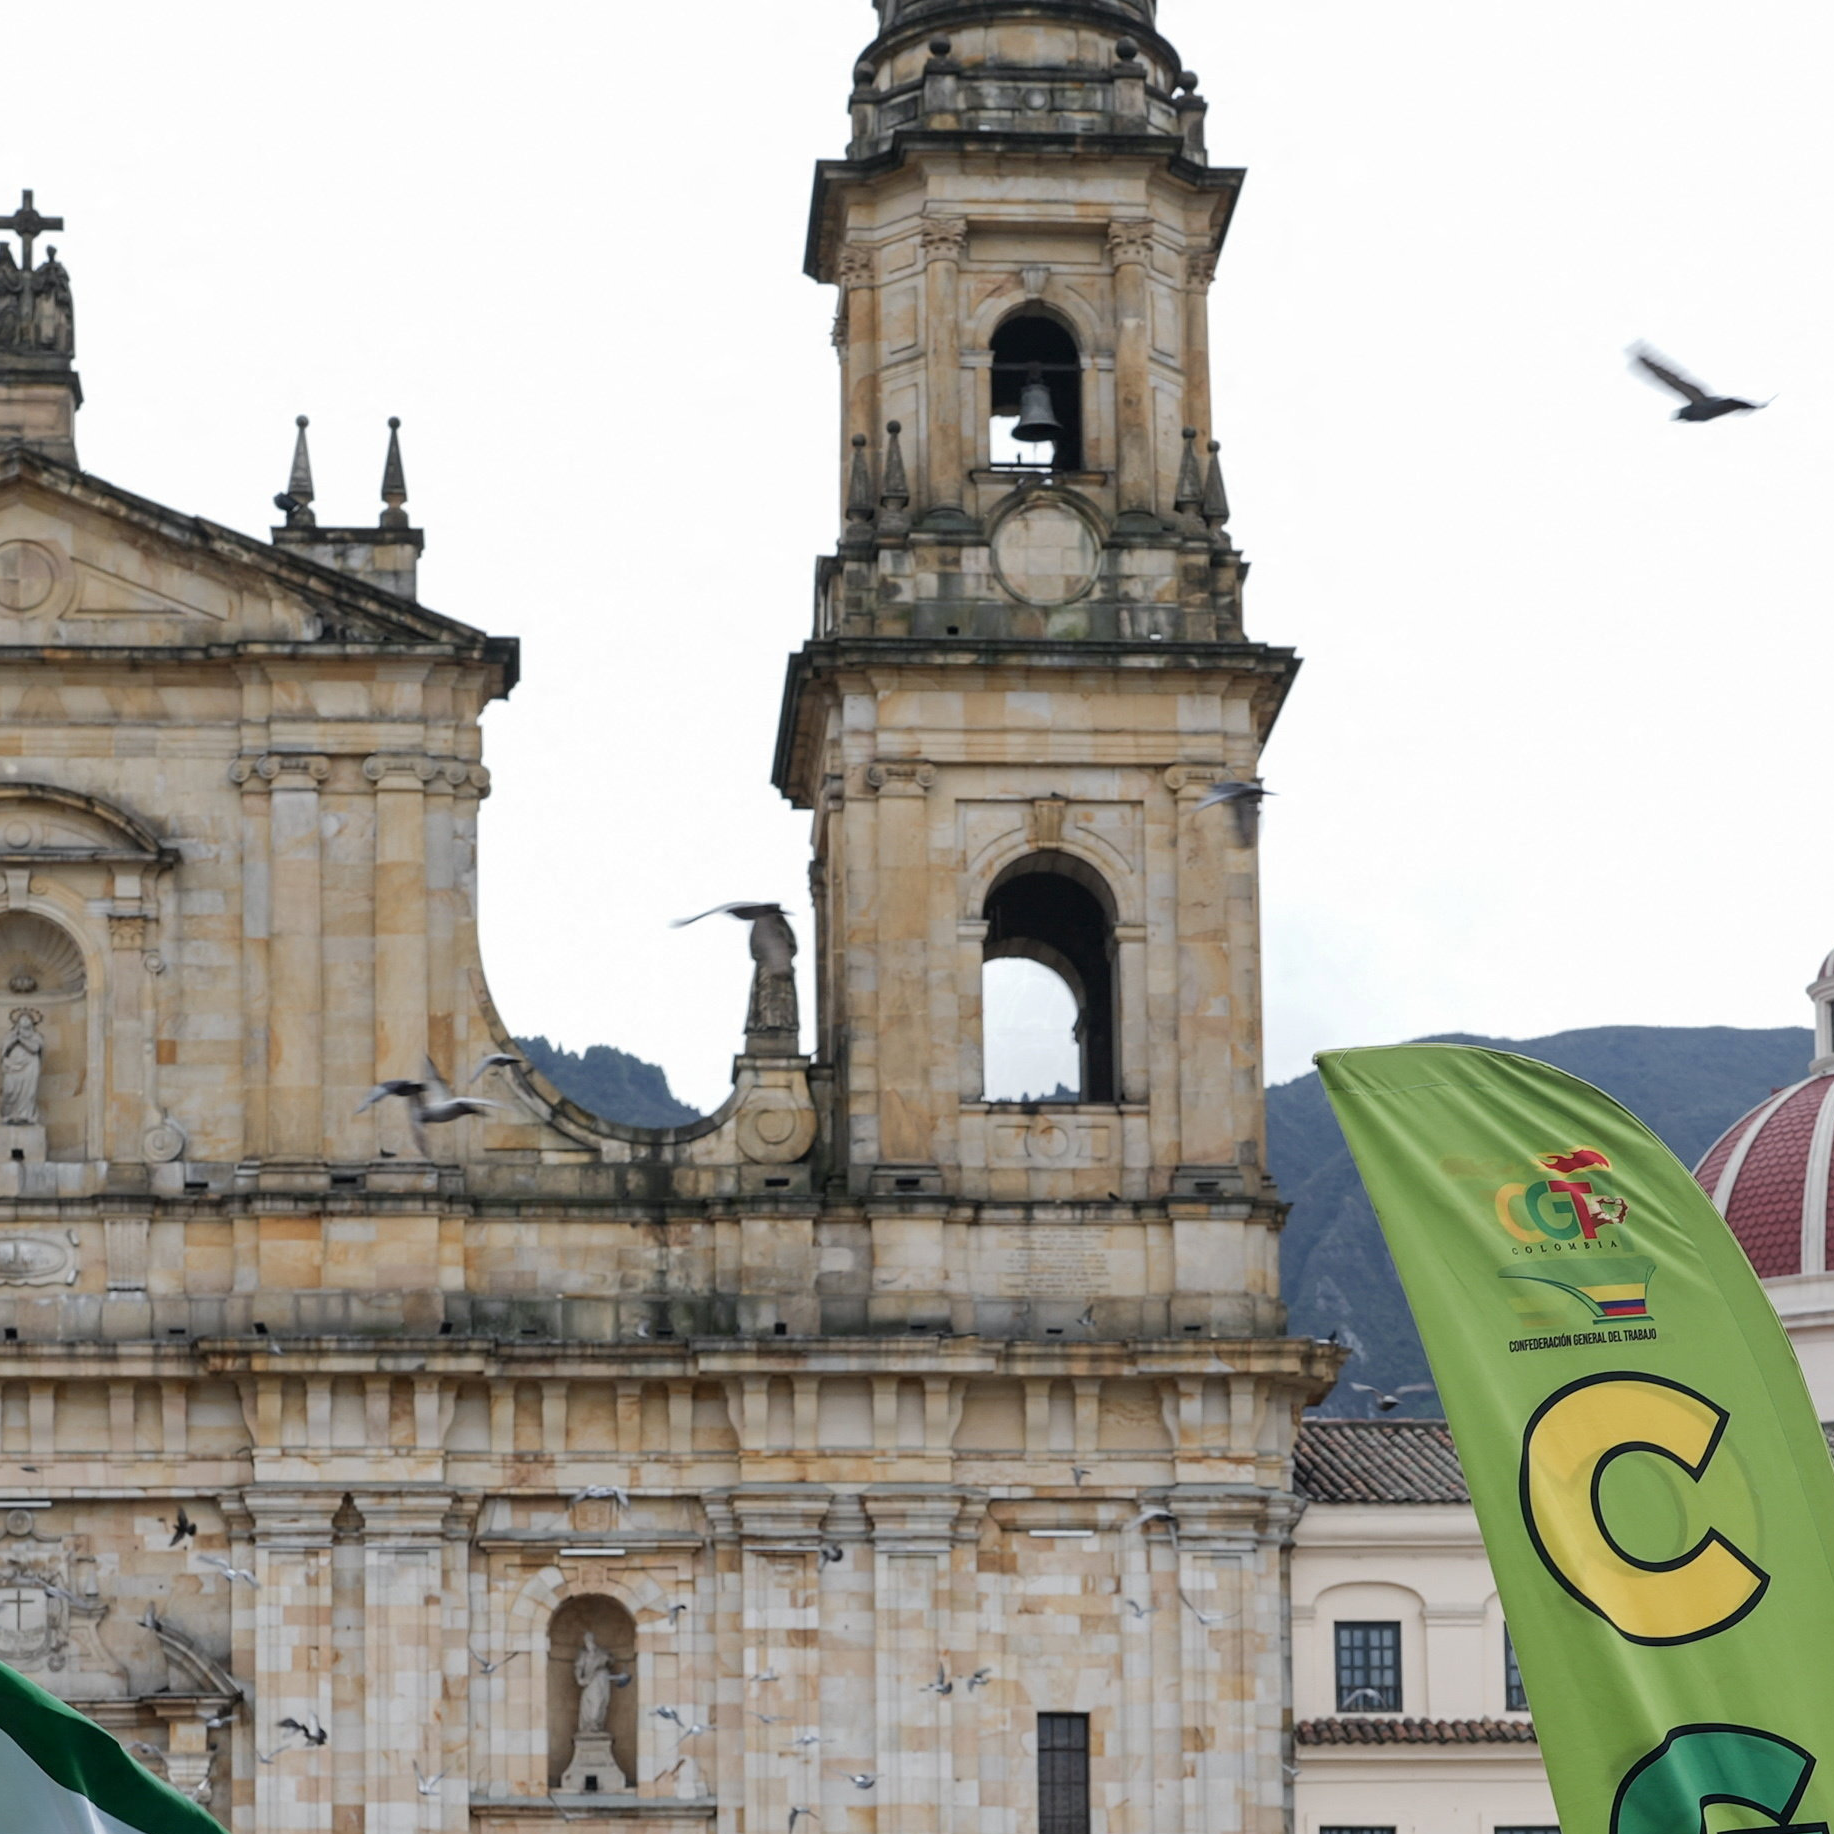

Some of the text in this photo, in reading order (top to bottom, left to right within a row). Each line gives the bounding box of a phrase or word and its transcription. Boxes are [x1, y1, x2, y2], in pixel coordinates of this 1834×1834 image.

[1495, 1180, 1598, 1243] CGT
[1512, 1240, 1618, 1256] COLOMBIA
[1509, 1328, 1657, 1353] CONFEDERACIÓN GENERAL DEL TRABAJO
